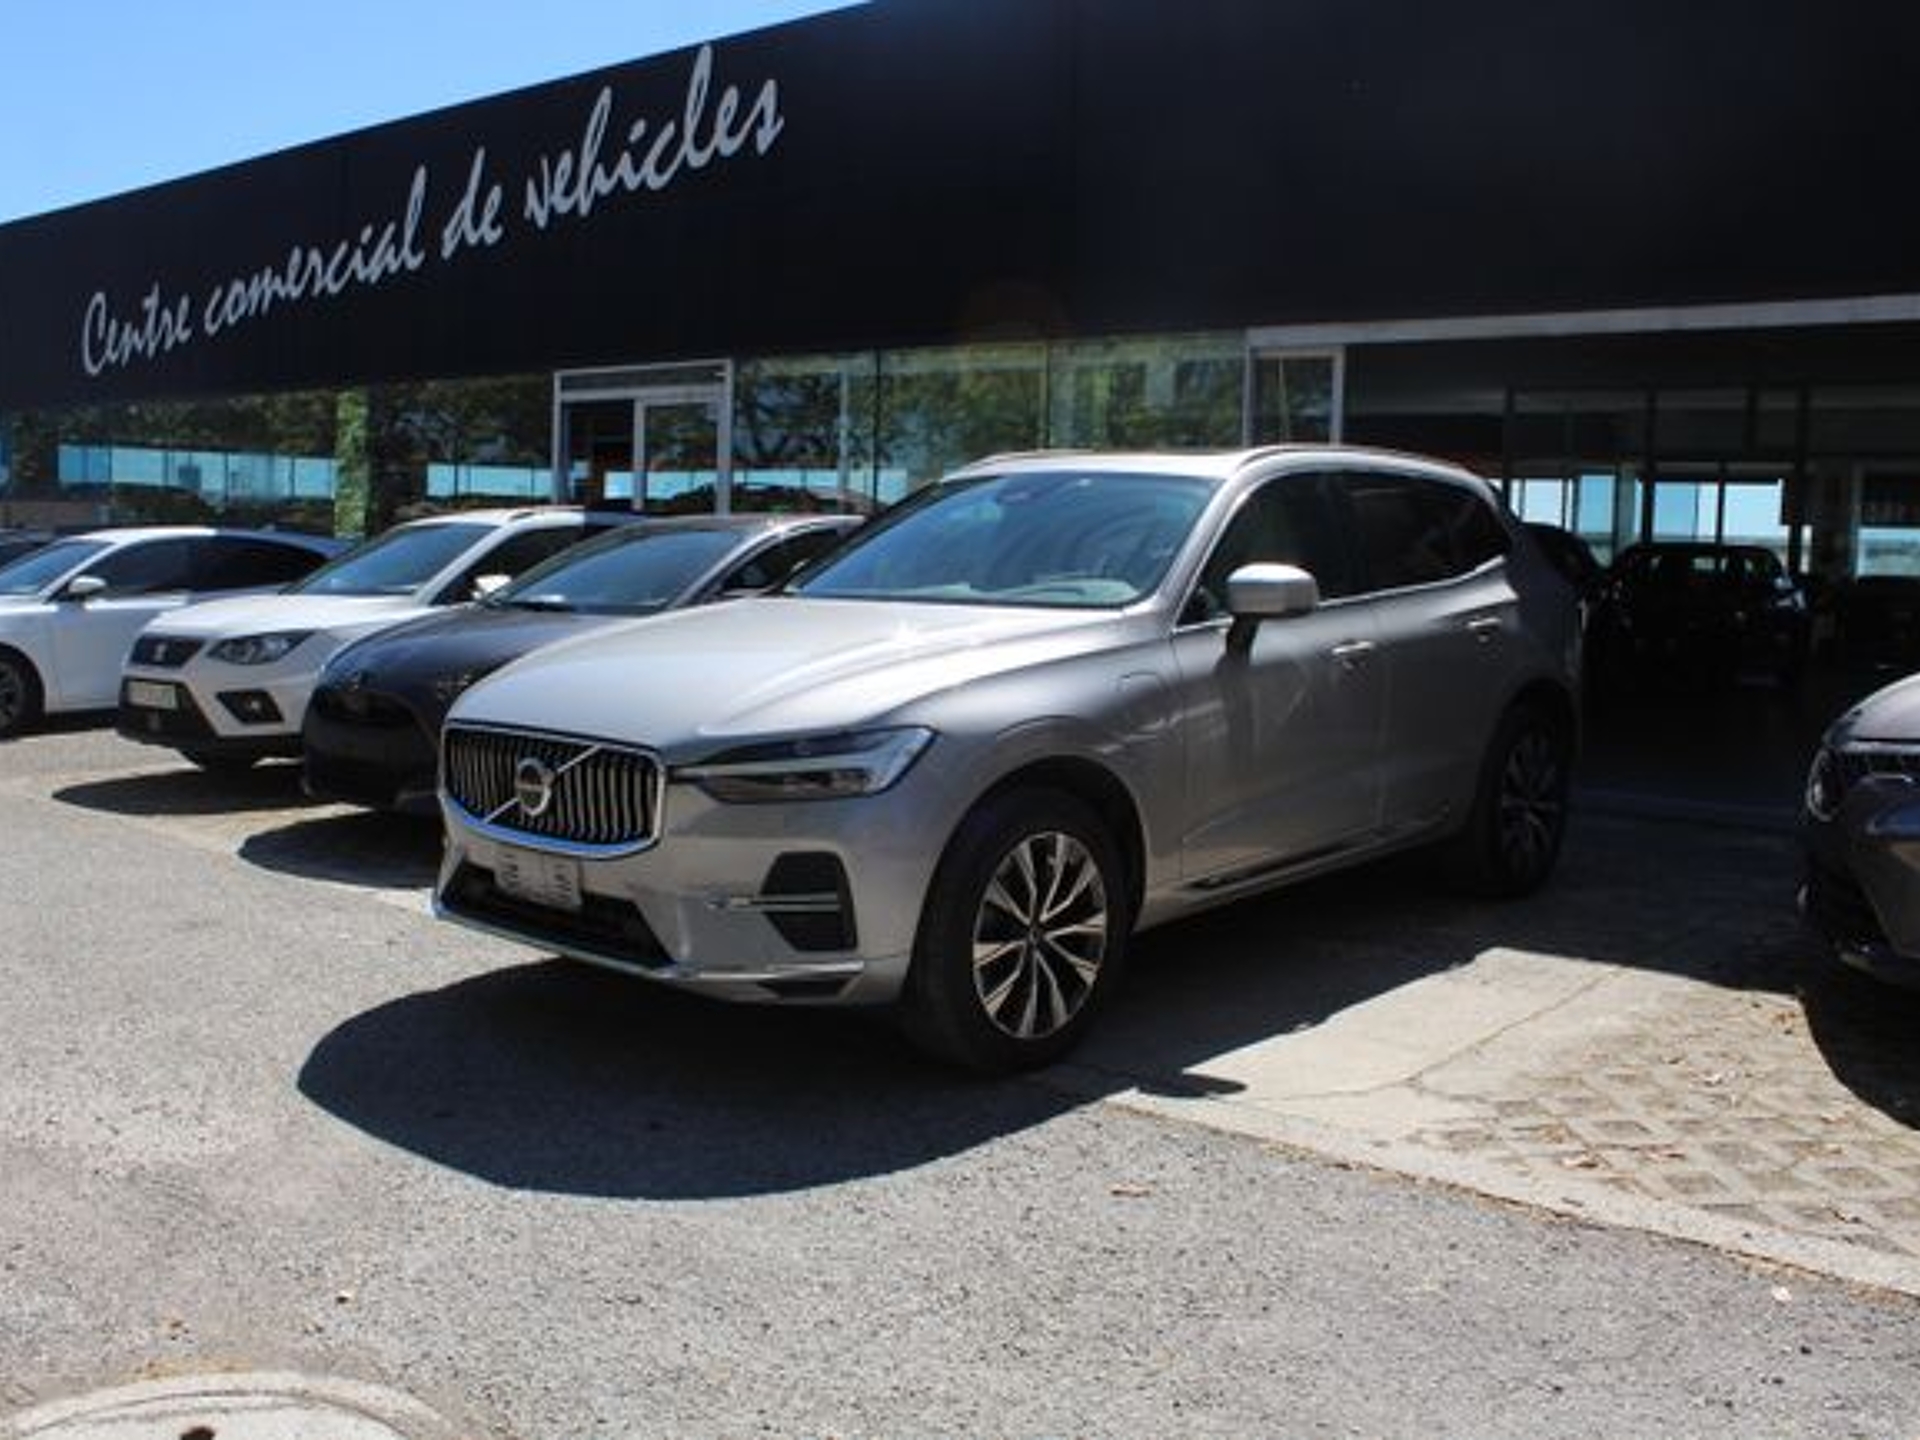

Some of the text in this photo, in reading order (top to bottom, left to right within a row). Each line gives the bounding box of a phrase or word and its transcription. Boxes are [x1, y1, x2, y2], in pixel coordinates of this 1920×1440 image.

[83, 44, 785, 377] Centre comercial de vehicles
